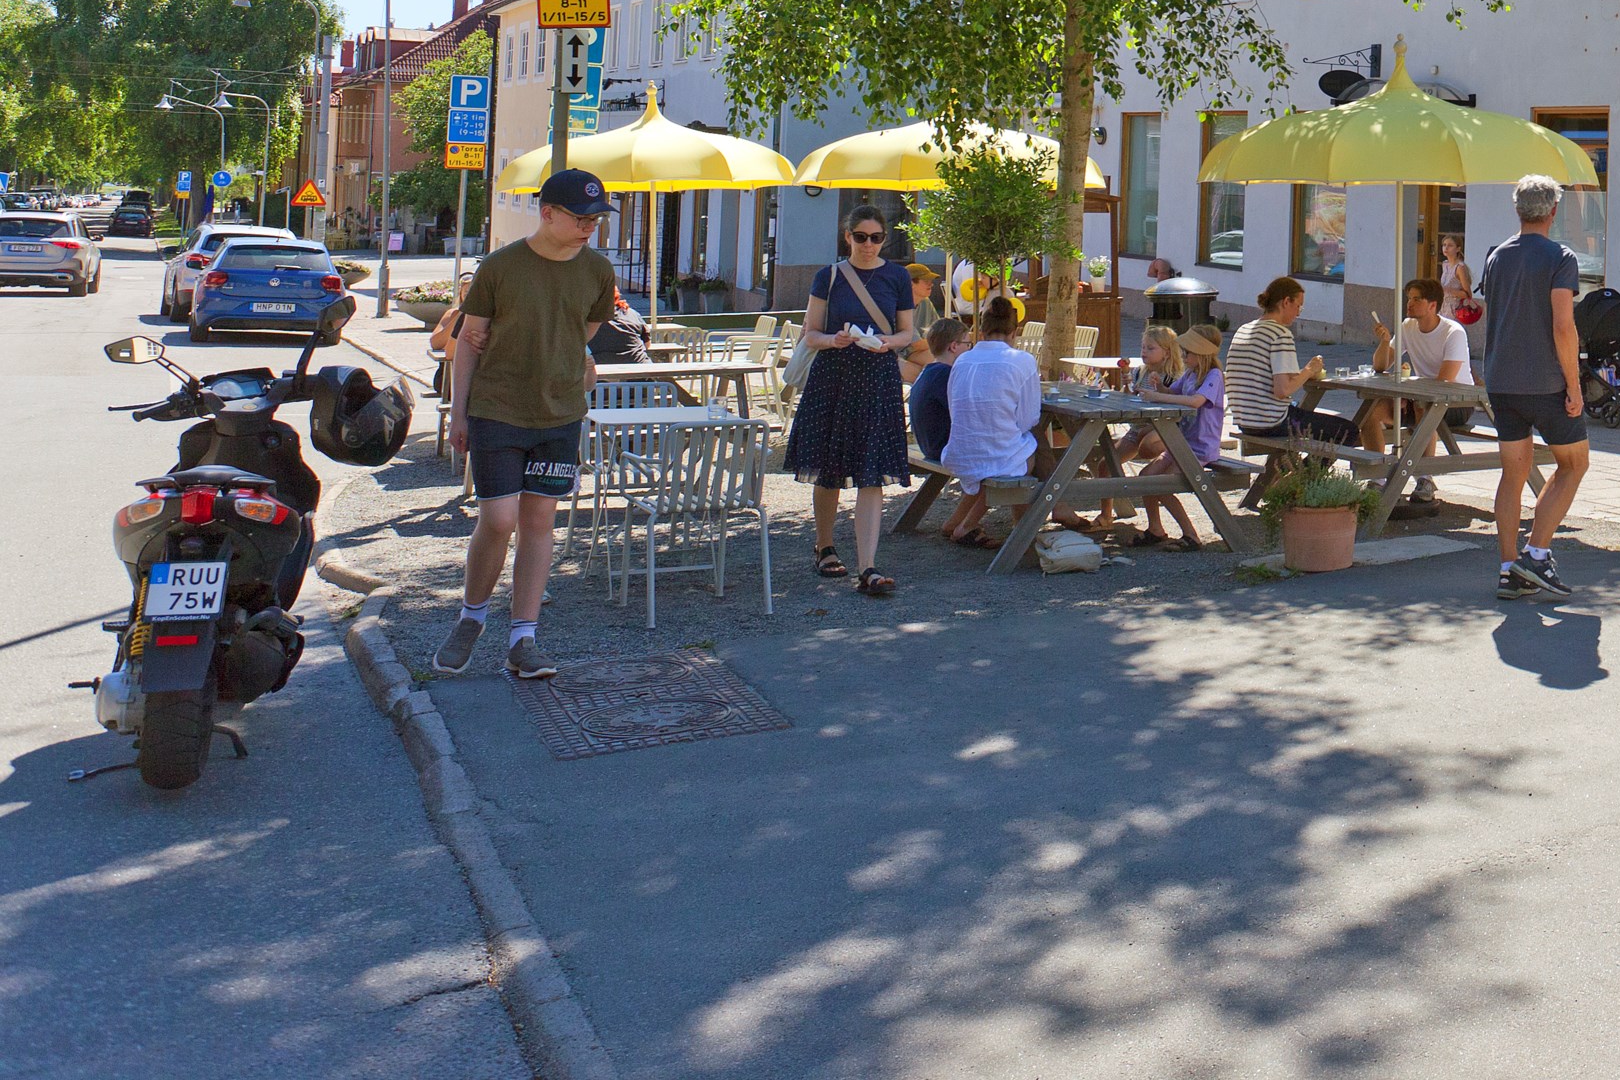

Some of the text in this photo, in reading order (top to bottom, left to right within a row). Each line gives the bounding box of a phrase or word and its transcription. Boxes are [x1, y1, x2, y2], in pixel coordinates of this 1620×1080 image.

[542, 11, 606, 22] 1/11-15/5
[460, 79, 482, 106] P
[459, 128, 485, 137] (9-15)
[449, 159, 482, 167] 1/11-15/5
[525, 461, 546, 476] LOS
[172, 567, 220, 586] RUU
[169, 591, 217, 610] 75W
[151, 614, 211, 622] KopEnScooter.Nu
